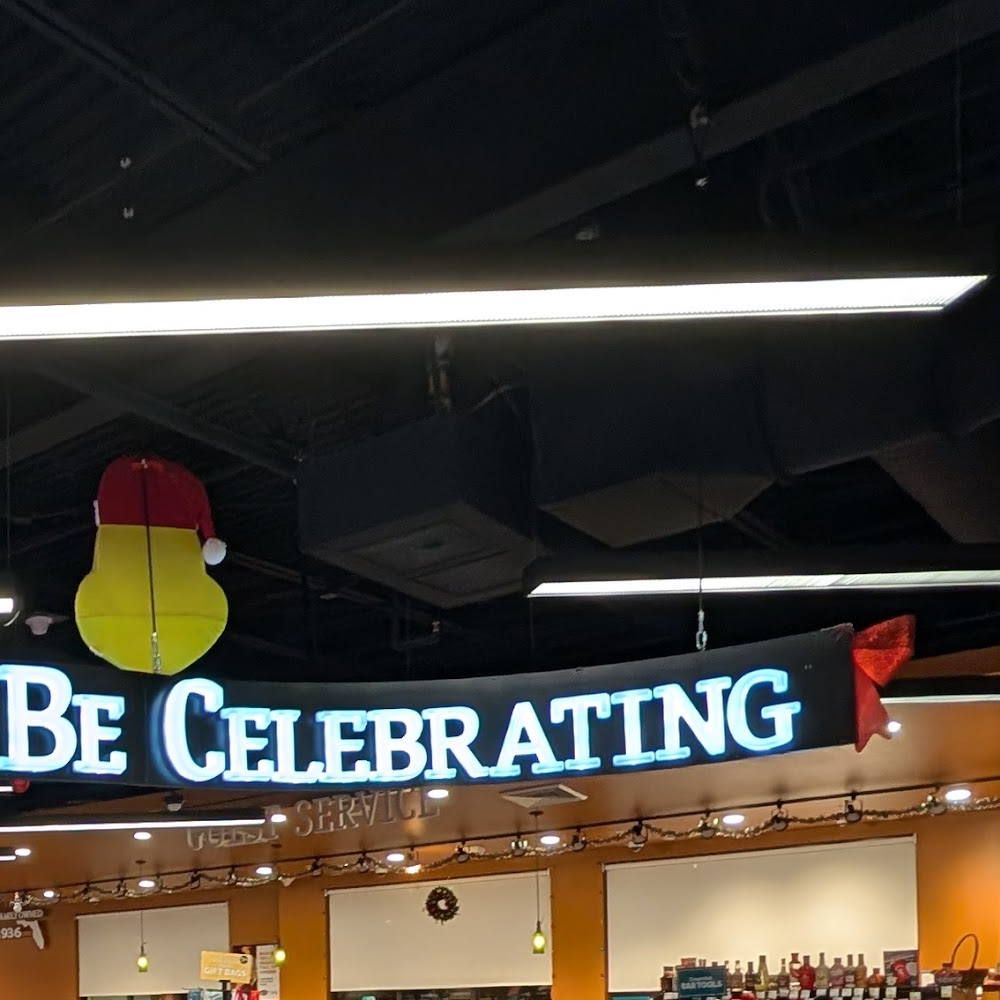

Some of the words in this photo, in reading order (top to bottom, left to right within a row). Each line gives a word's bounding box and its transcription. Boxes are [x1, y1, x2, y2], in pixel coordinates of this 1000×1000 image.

[162, 667, 802, 785] CELEBRATING
[17, 909, 44, 919] OWNED
[203, 967, 225, 976] GIFT
[225, 968, 248, 978] BAGS
